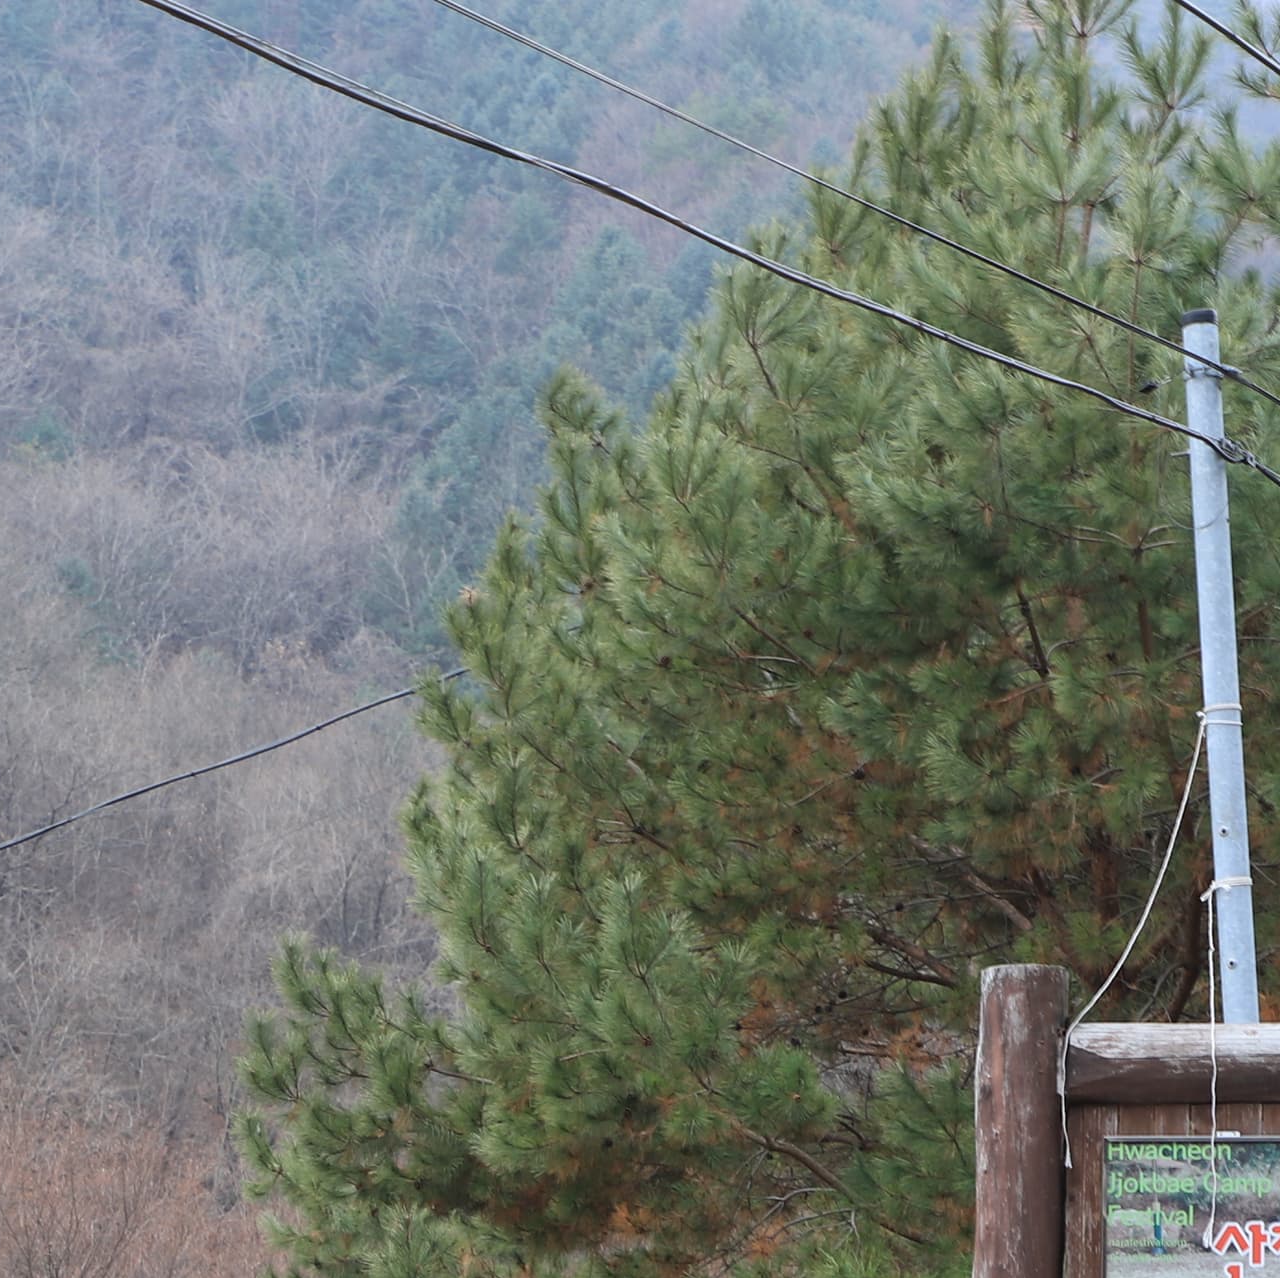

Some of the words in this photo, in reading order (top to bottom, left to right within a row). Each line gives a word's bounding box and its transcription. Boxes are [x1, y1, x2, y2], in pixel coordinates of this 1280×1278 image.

[1107, 1142, 1232, 1161] Hwacheon
[1107, 1172, 1196, 1198] Jjokbae
[1203, 1172, 1273, 1197] Camp
[1107, 1205, 1195, 1227] Festival
